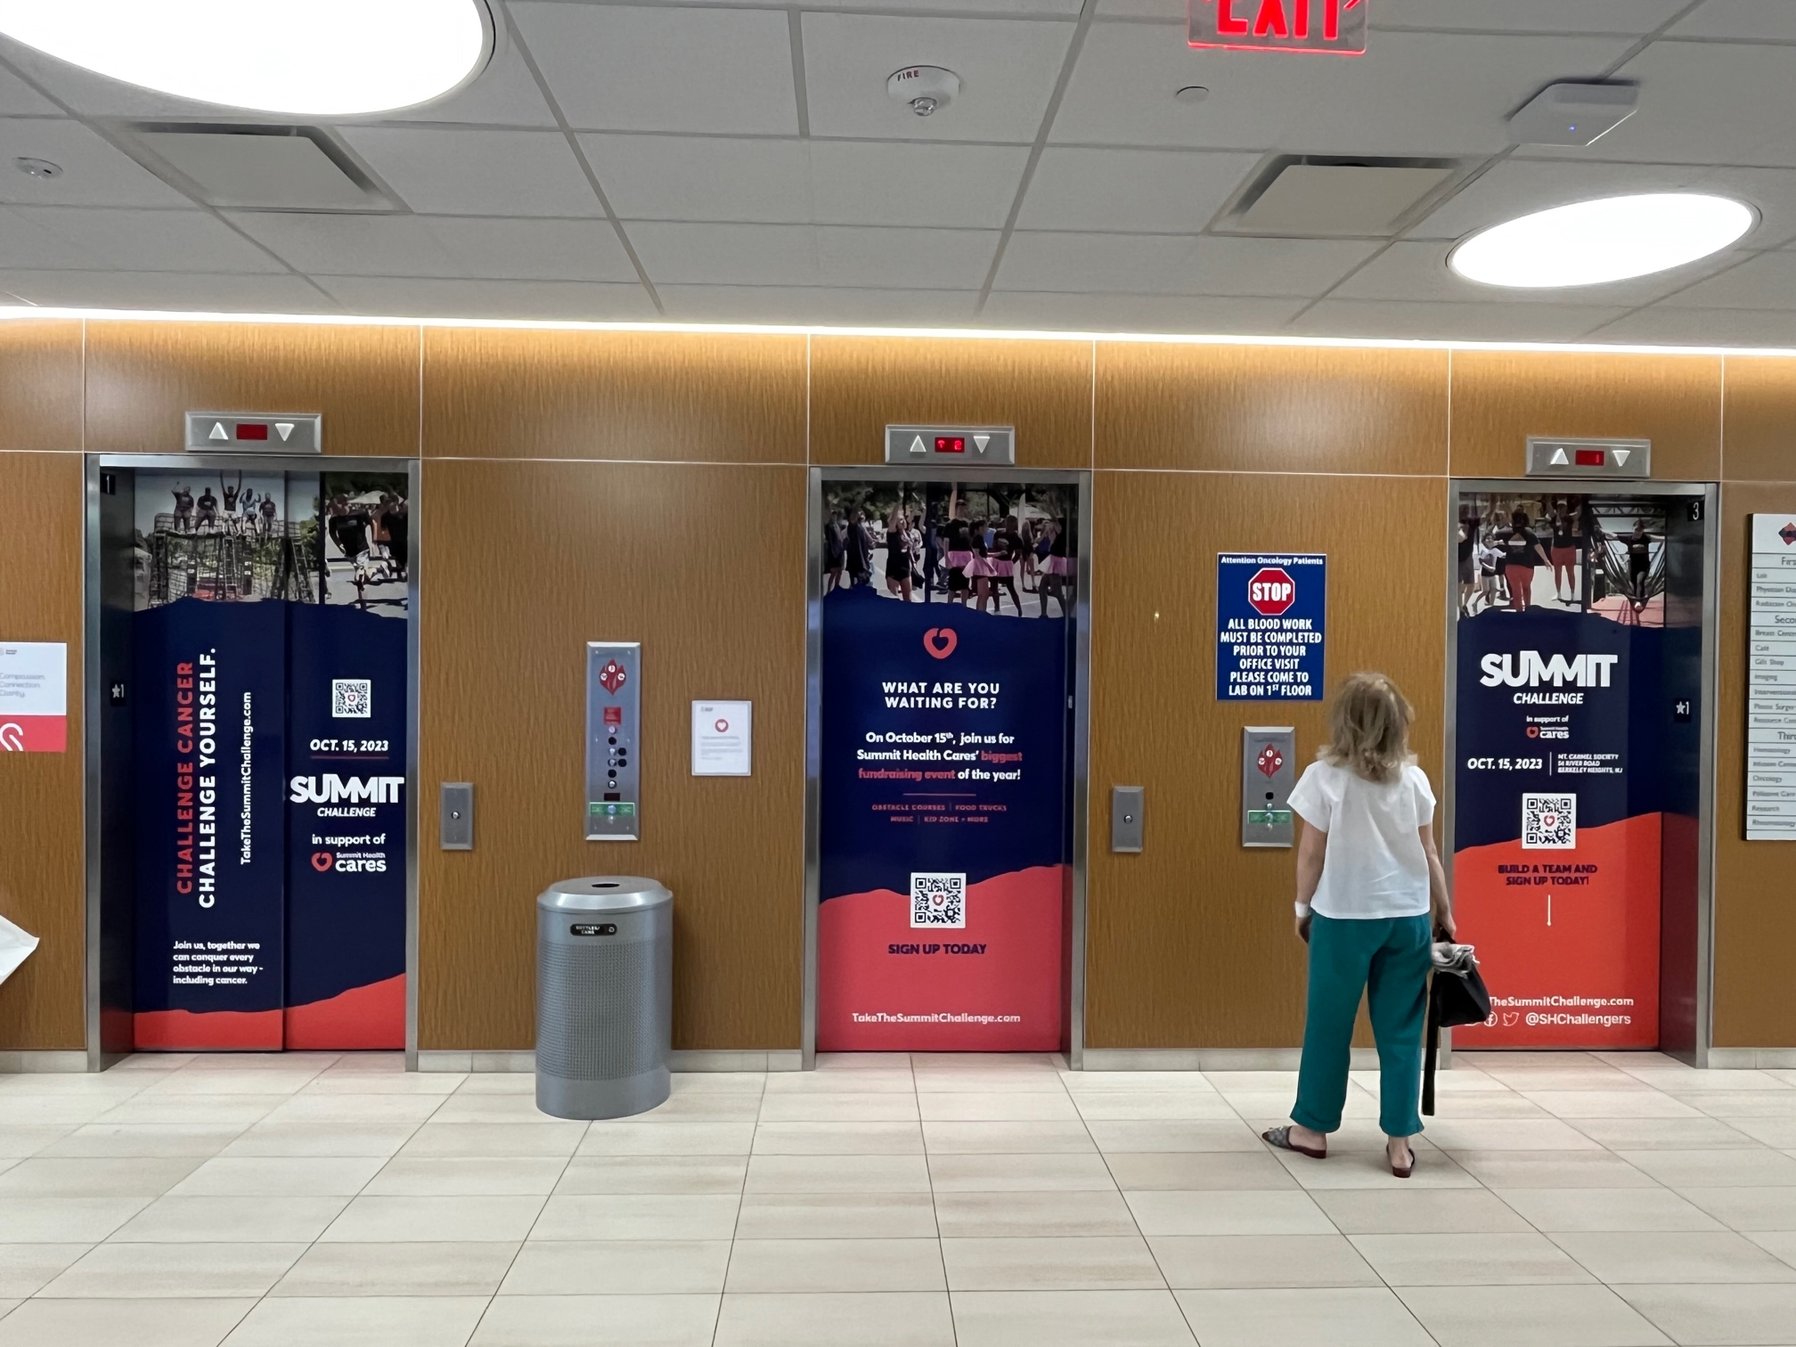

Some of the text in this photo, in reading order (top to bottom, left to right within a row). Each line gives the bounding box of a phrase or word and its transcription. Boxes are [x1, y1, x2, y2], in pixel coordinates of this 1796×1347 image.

[898, 70, 919, 81] FIRE
[1692, 501, 1700, 521] 3
[1257, 557, 1292, 566] Oncology
[1252, 582, 1291, 601] STOP
[1228, 619, 1312, 629] ALL BLOOD WORK
[1220, 632, 1322, 643] MUST BE COMPLETED
[1233, 645, 1306, 656] PRIOR TO YOUR
[1240, 659, 1300, 669] OFFICE VISIT
[1480, 650, 1618, 687] SUMMIT
[1230, 672, 1309, 682] PLEASE COME TO
[882, 682, 1000, 694] WHAT ARE YOU
[1229, 684, 1312, 696] LAB ON 1ST FLOOR
[885, 697, 997, 709] WAITING FOR?
[1513, 692, 1584, 704] CHALLENGE
[866, 732, 1015, 746] On October 15th, join us for
[310, 739, 389, 753] OCT. 15, 2023
[856, 749, 901, 760] Summit
[903, 750, 941, 761] Health
[981, 751, 1023, 764] biggest
[1468, 758, 1542, 770] OCT. 15, 2023
[177, 662, 193, 894] CHALLENGE CANCER
[198, 648, 216, 908] CHALLENGE YOURSELF.
[241, 691, 253, 865] TakeTheSummitChallenge.com
[858, 768, 1020, 782] fundraising event of the year!
[290, 774, 405, 803] SUMMIT
[317, 807, 376, 817] CHALLENGE
[312, 833, 386, 847] in support of
[335, 860, 387, 872] cares
[1498, 864, 1598, 873] BUILD A TEAM AND
[1506, 876, 1589, 885] SIGN UP TODAY!
[173, 940, 192, 949] Join
[207, 941, 245, 951] together
[888, 944, 987, 954] SIGN UP TODAY
[191, 954, 228, 963] conquer
[173, 964, 210, 972] obstacle
[212, 964, 220, 972] in
[239, 966, 257, 974] way
[173, 975, 214, 986] including
[1489, 996, 1634, 1008] TheSummitChallenge.com
[852, 1012, 1020, 1024] TakeTheSummitChallenge.com
[1525, 1013, 1631, 1027] @SHChallengers
